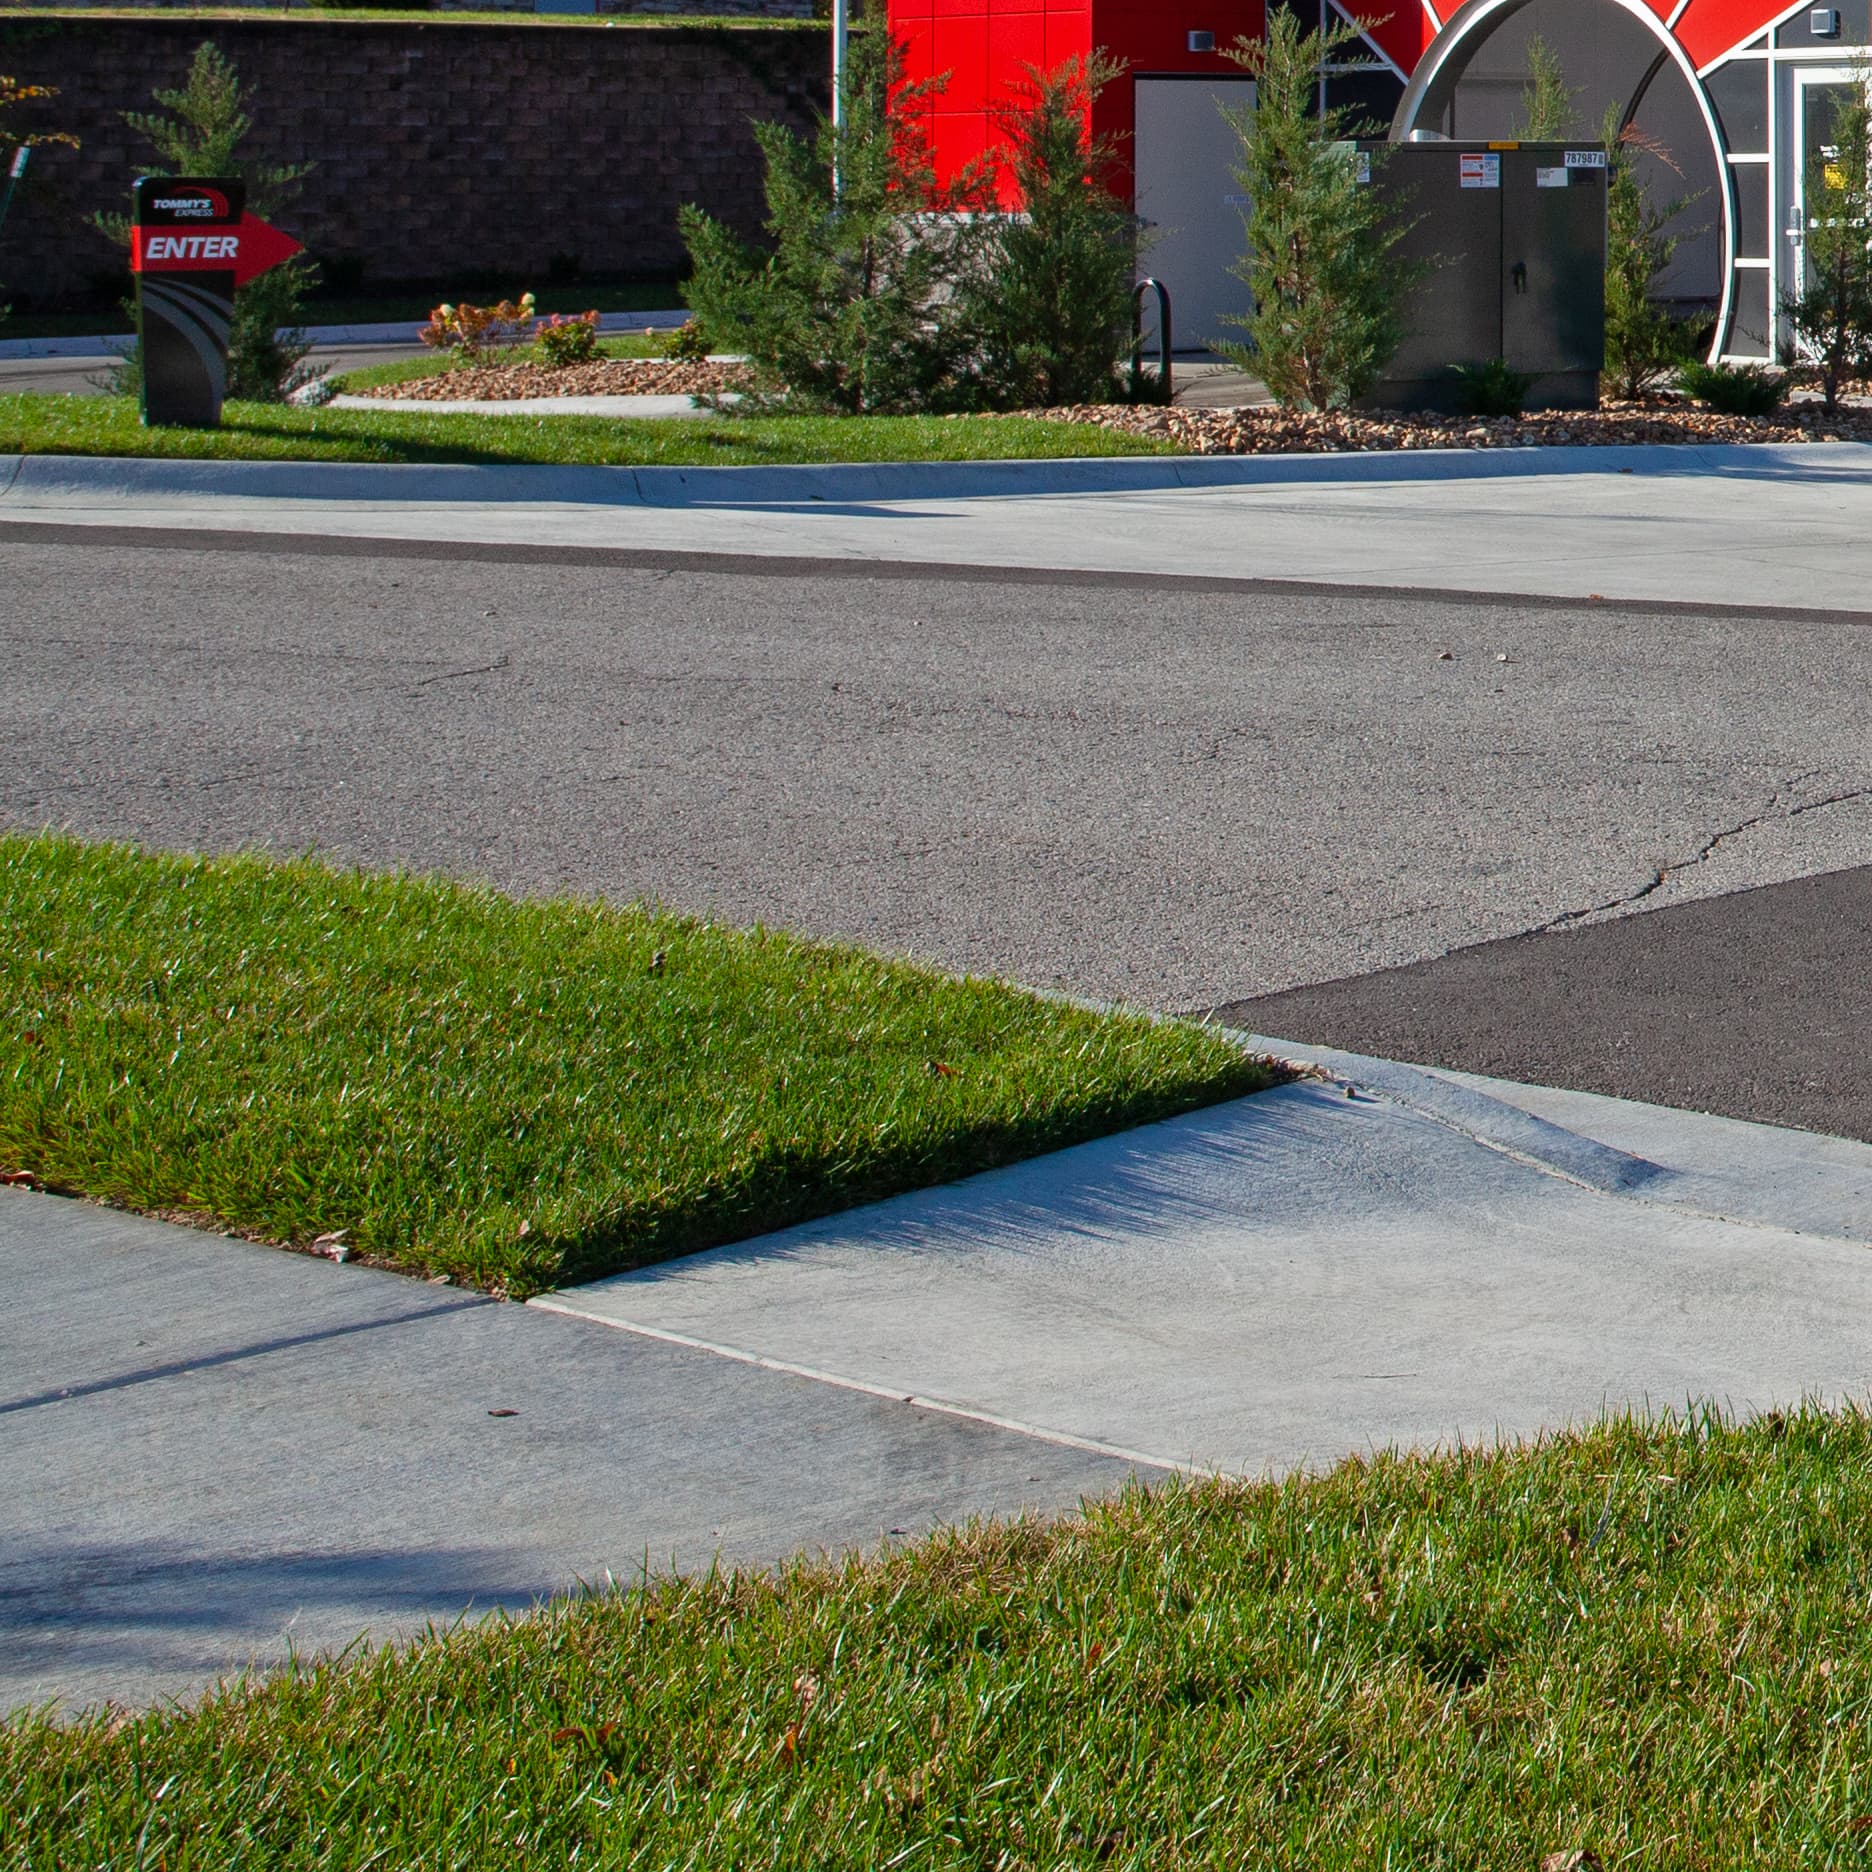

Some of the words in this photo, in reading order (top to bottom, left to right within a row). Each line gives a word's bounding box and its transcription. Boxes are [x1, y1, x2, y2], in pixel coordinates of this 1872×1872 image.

[153, 199, 211, 209] TOMMY'S
[174, 209, 214, 217] EXPRESS
[146, 237, 239, 259] ENTER
